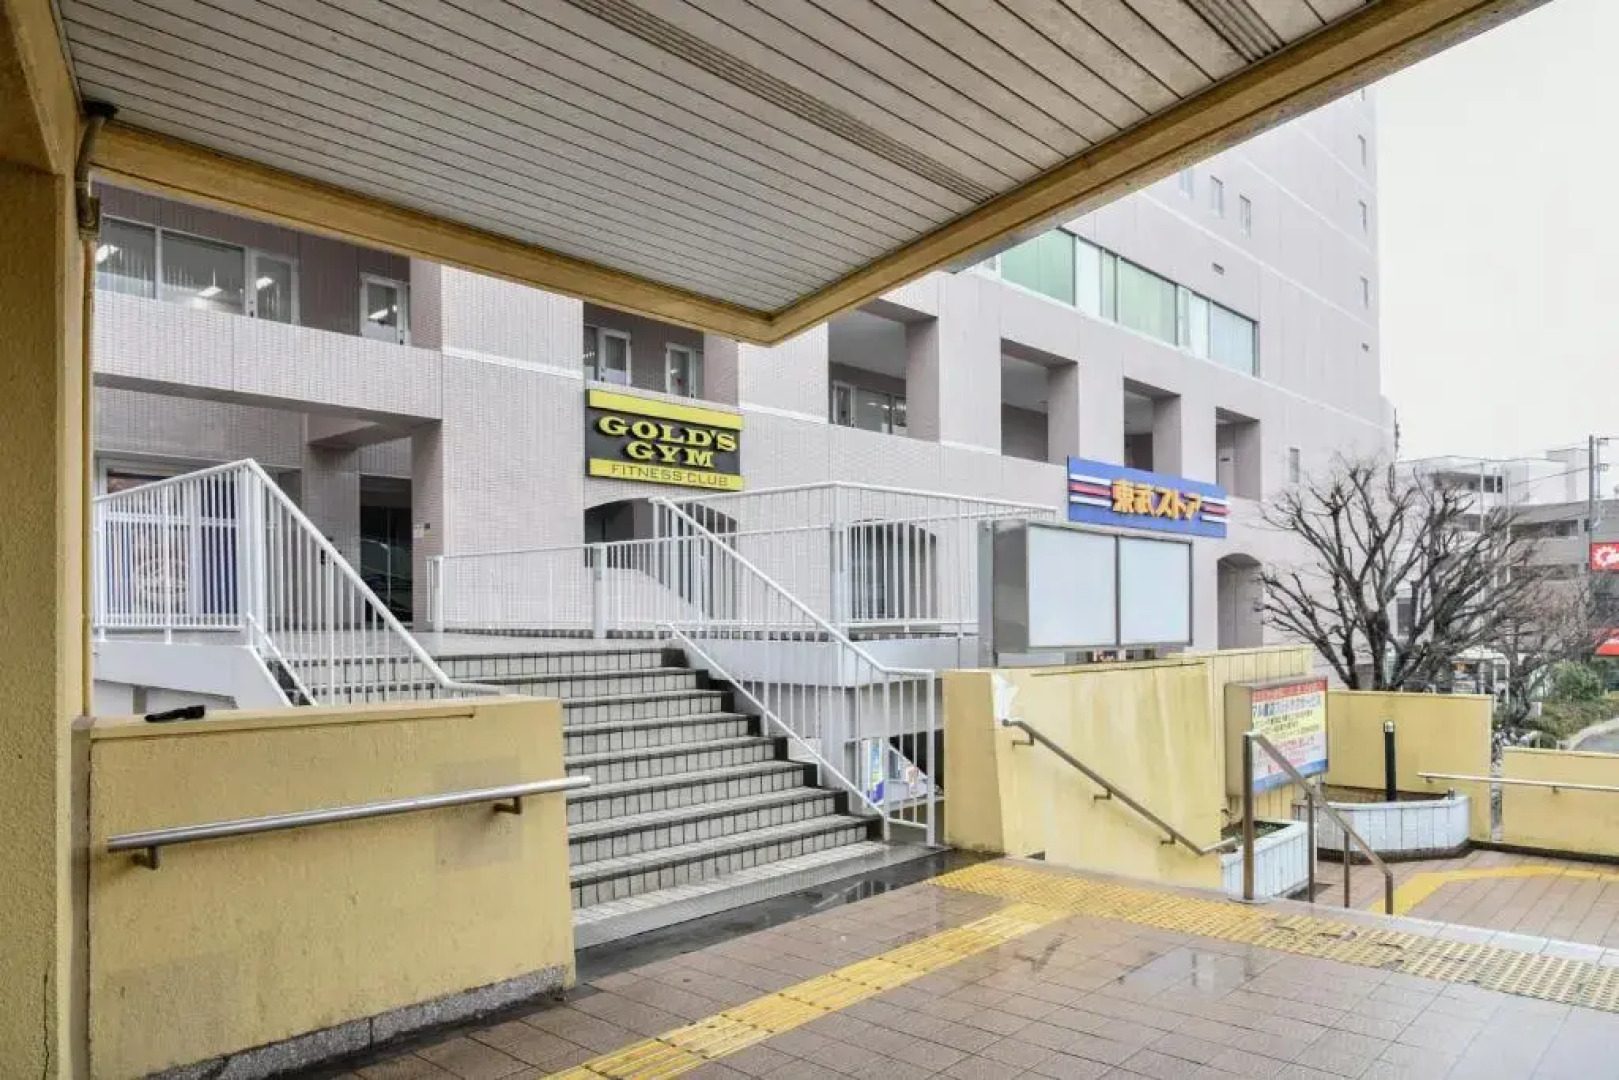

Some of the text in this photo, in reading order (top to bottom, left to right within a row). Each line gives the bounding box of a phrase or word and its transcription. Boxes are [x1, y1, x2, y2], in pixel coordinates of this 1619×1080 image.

[598, 415, 736, 452] GOLD'S
[626, 440, 714, 467] GYM
[611, 463, 728, 486] FITNESS CLUB
[1112, 478, 1202, 520] 東武ストア
